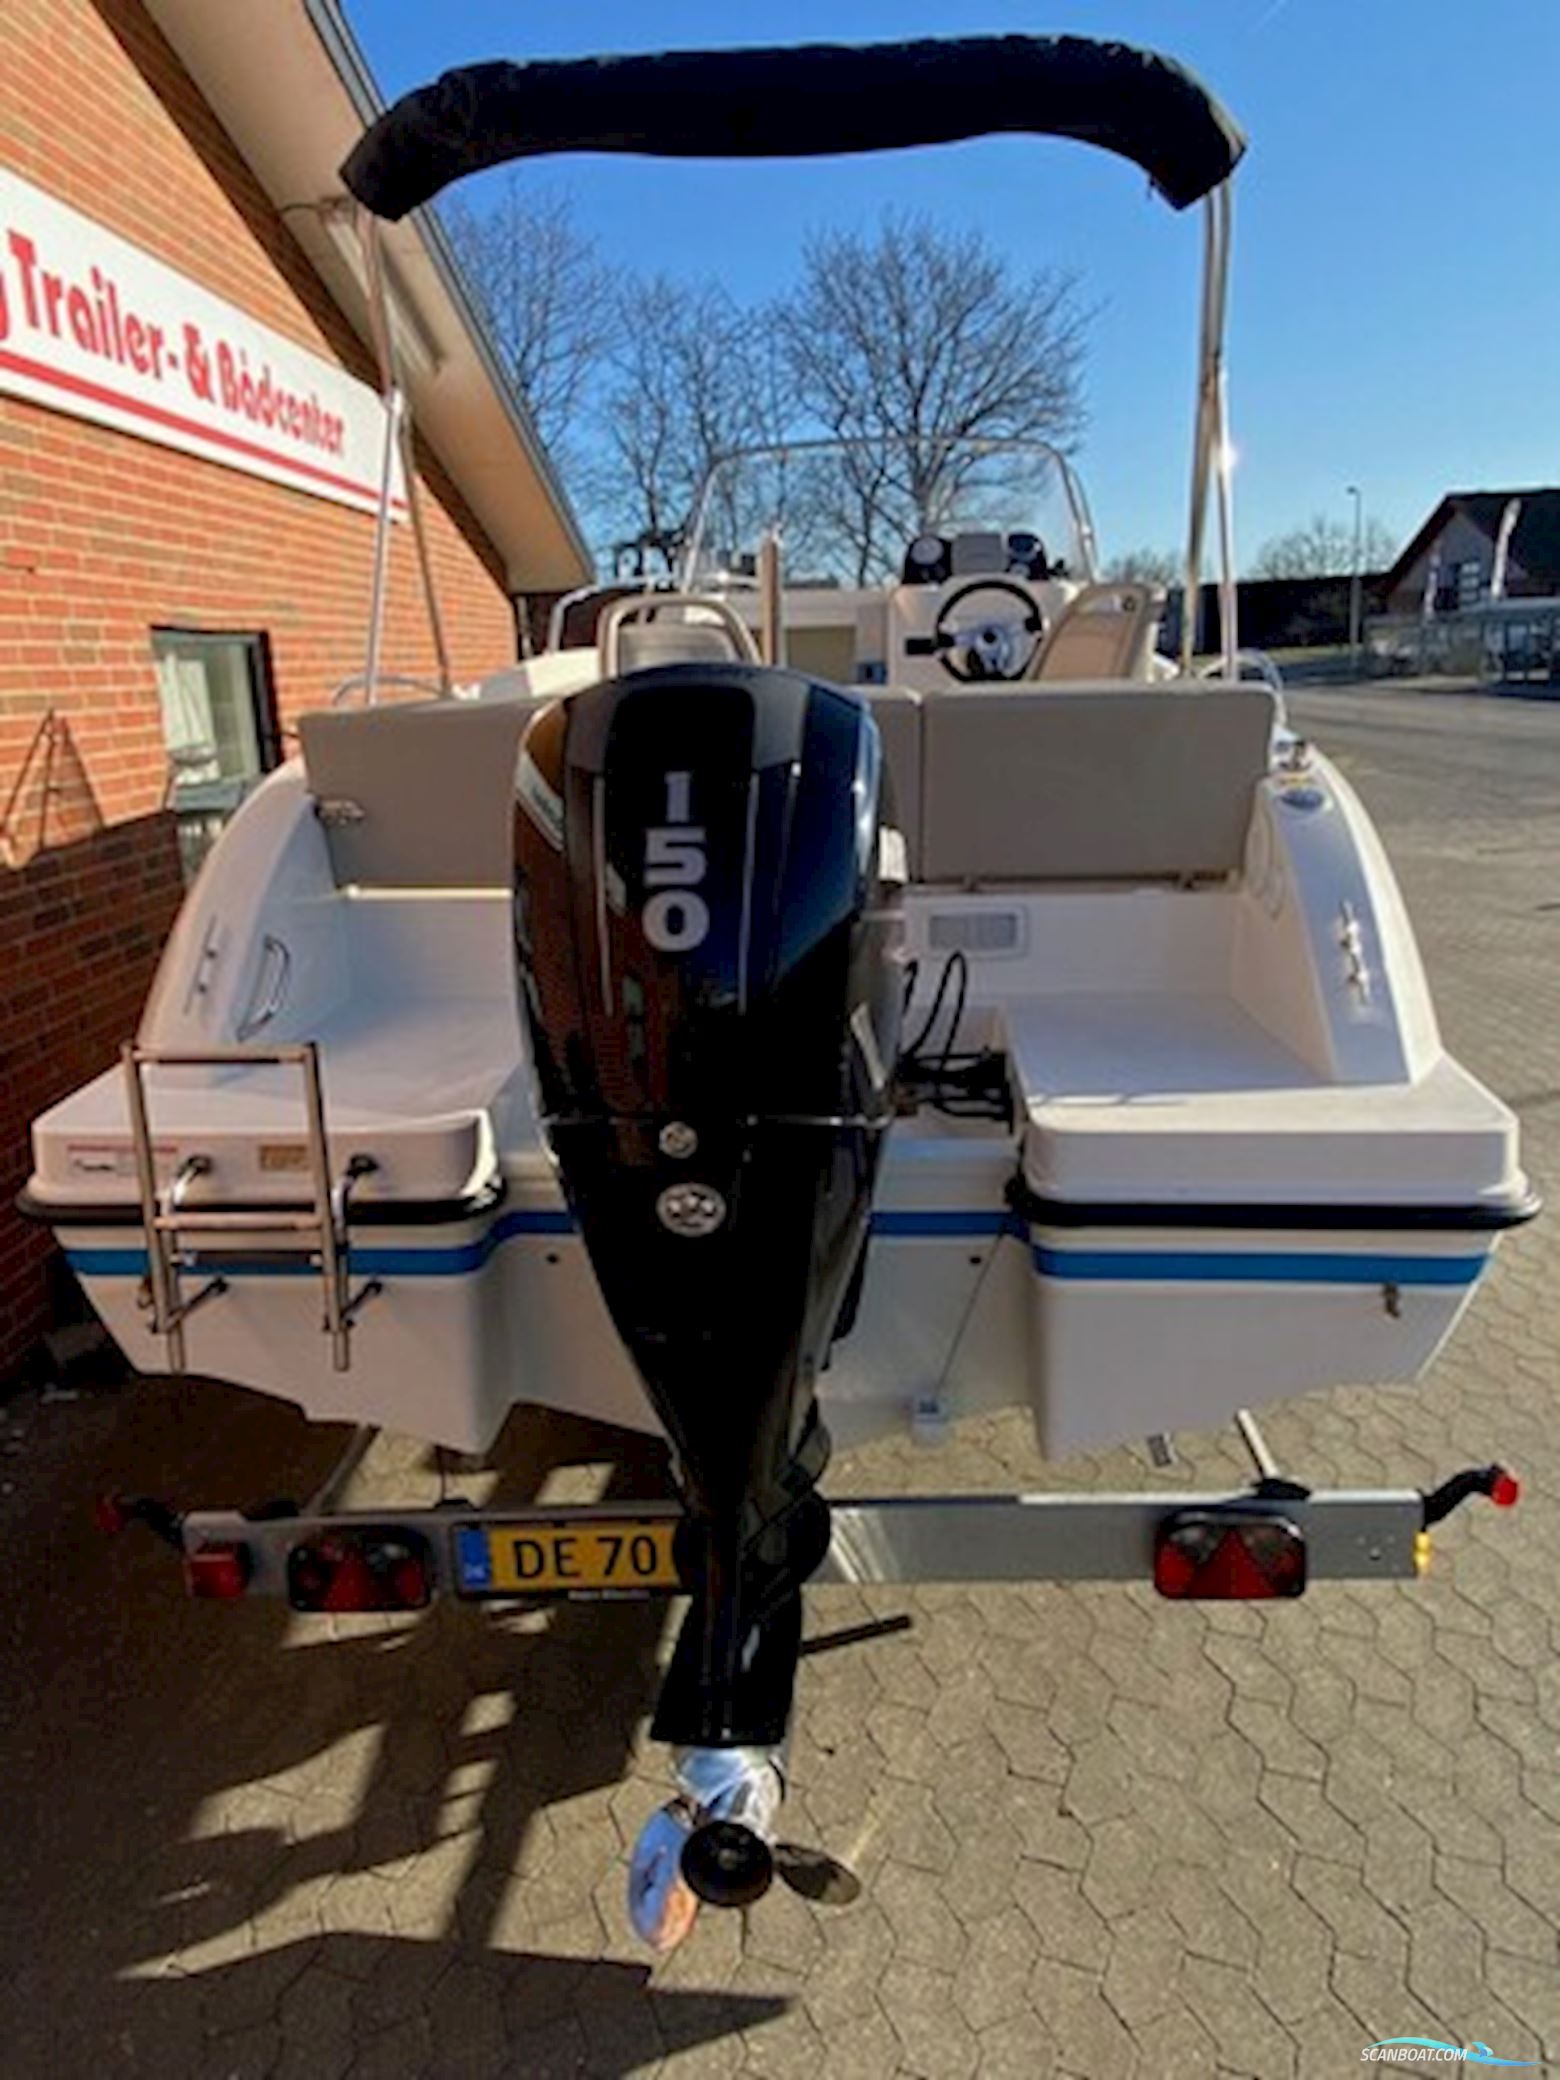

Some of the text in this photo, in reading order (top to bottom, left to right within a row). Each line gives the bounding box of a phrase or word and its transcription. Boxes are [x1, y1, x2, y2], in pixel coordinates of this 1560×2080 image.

[7, 228, 179, 382] Trailer-
[183, 321, 215, 404] &
[641, 771, 710, 952] 150
[512, 1534, 658, 1578] DE 70
